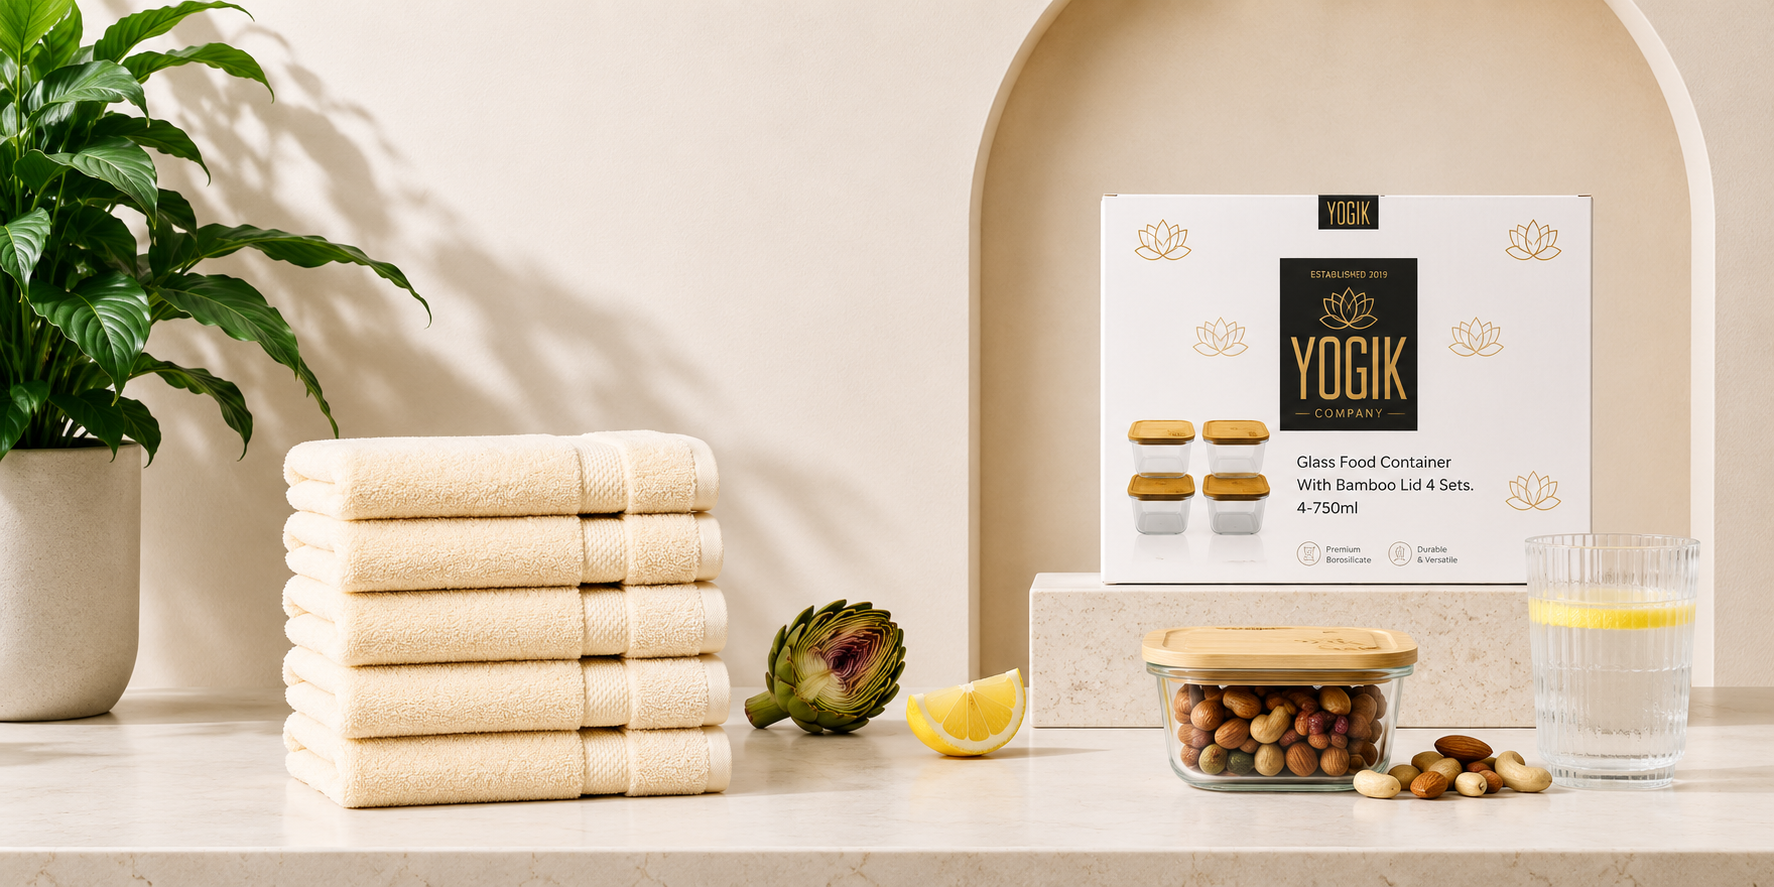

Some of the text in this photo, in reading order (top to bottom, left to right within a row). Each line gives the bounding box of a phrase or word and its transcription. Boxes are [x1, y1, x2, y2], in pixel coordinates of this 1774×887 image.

[1327, 201, 1370, 225] YOGIK
[1311, 270, 1387, 279] ESTABLISHED 2019
[1291, 336, 1407, 400] YOGIK
[1315, 409, 1382, 419] COMPANY
[1297, 456, 1451, 468] Glass Food Container
[1297, 479, 1473, 491] With Bamboo Lid 4 Sets.
[1297, 501, 1357, 514] 4-750ml
[1326, 546, 1360, 554] Premium
[1418, 546, 1447, 554] Durable
[1326, 556, 1371, 564] Borosilicate
[1417, 556, 1423, 564] &
